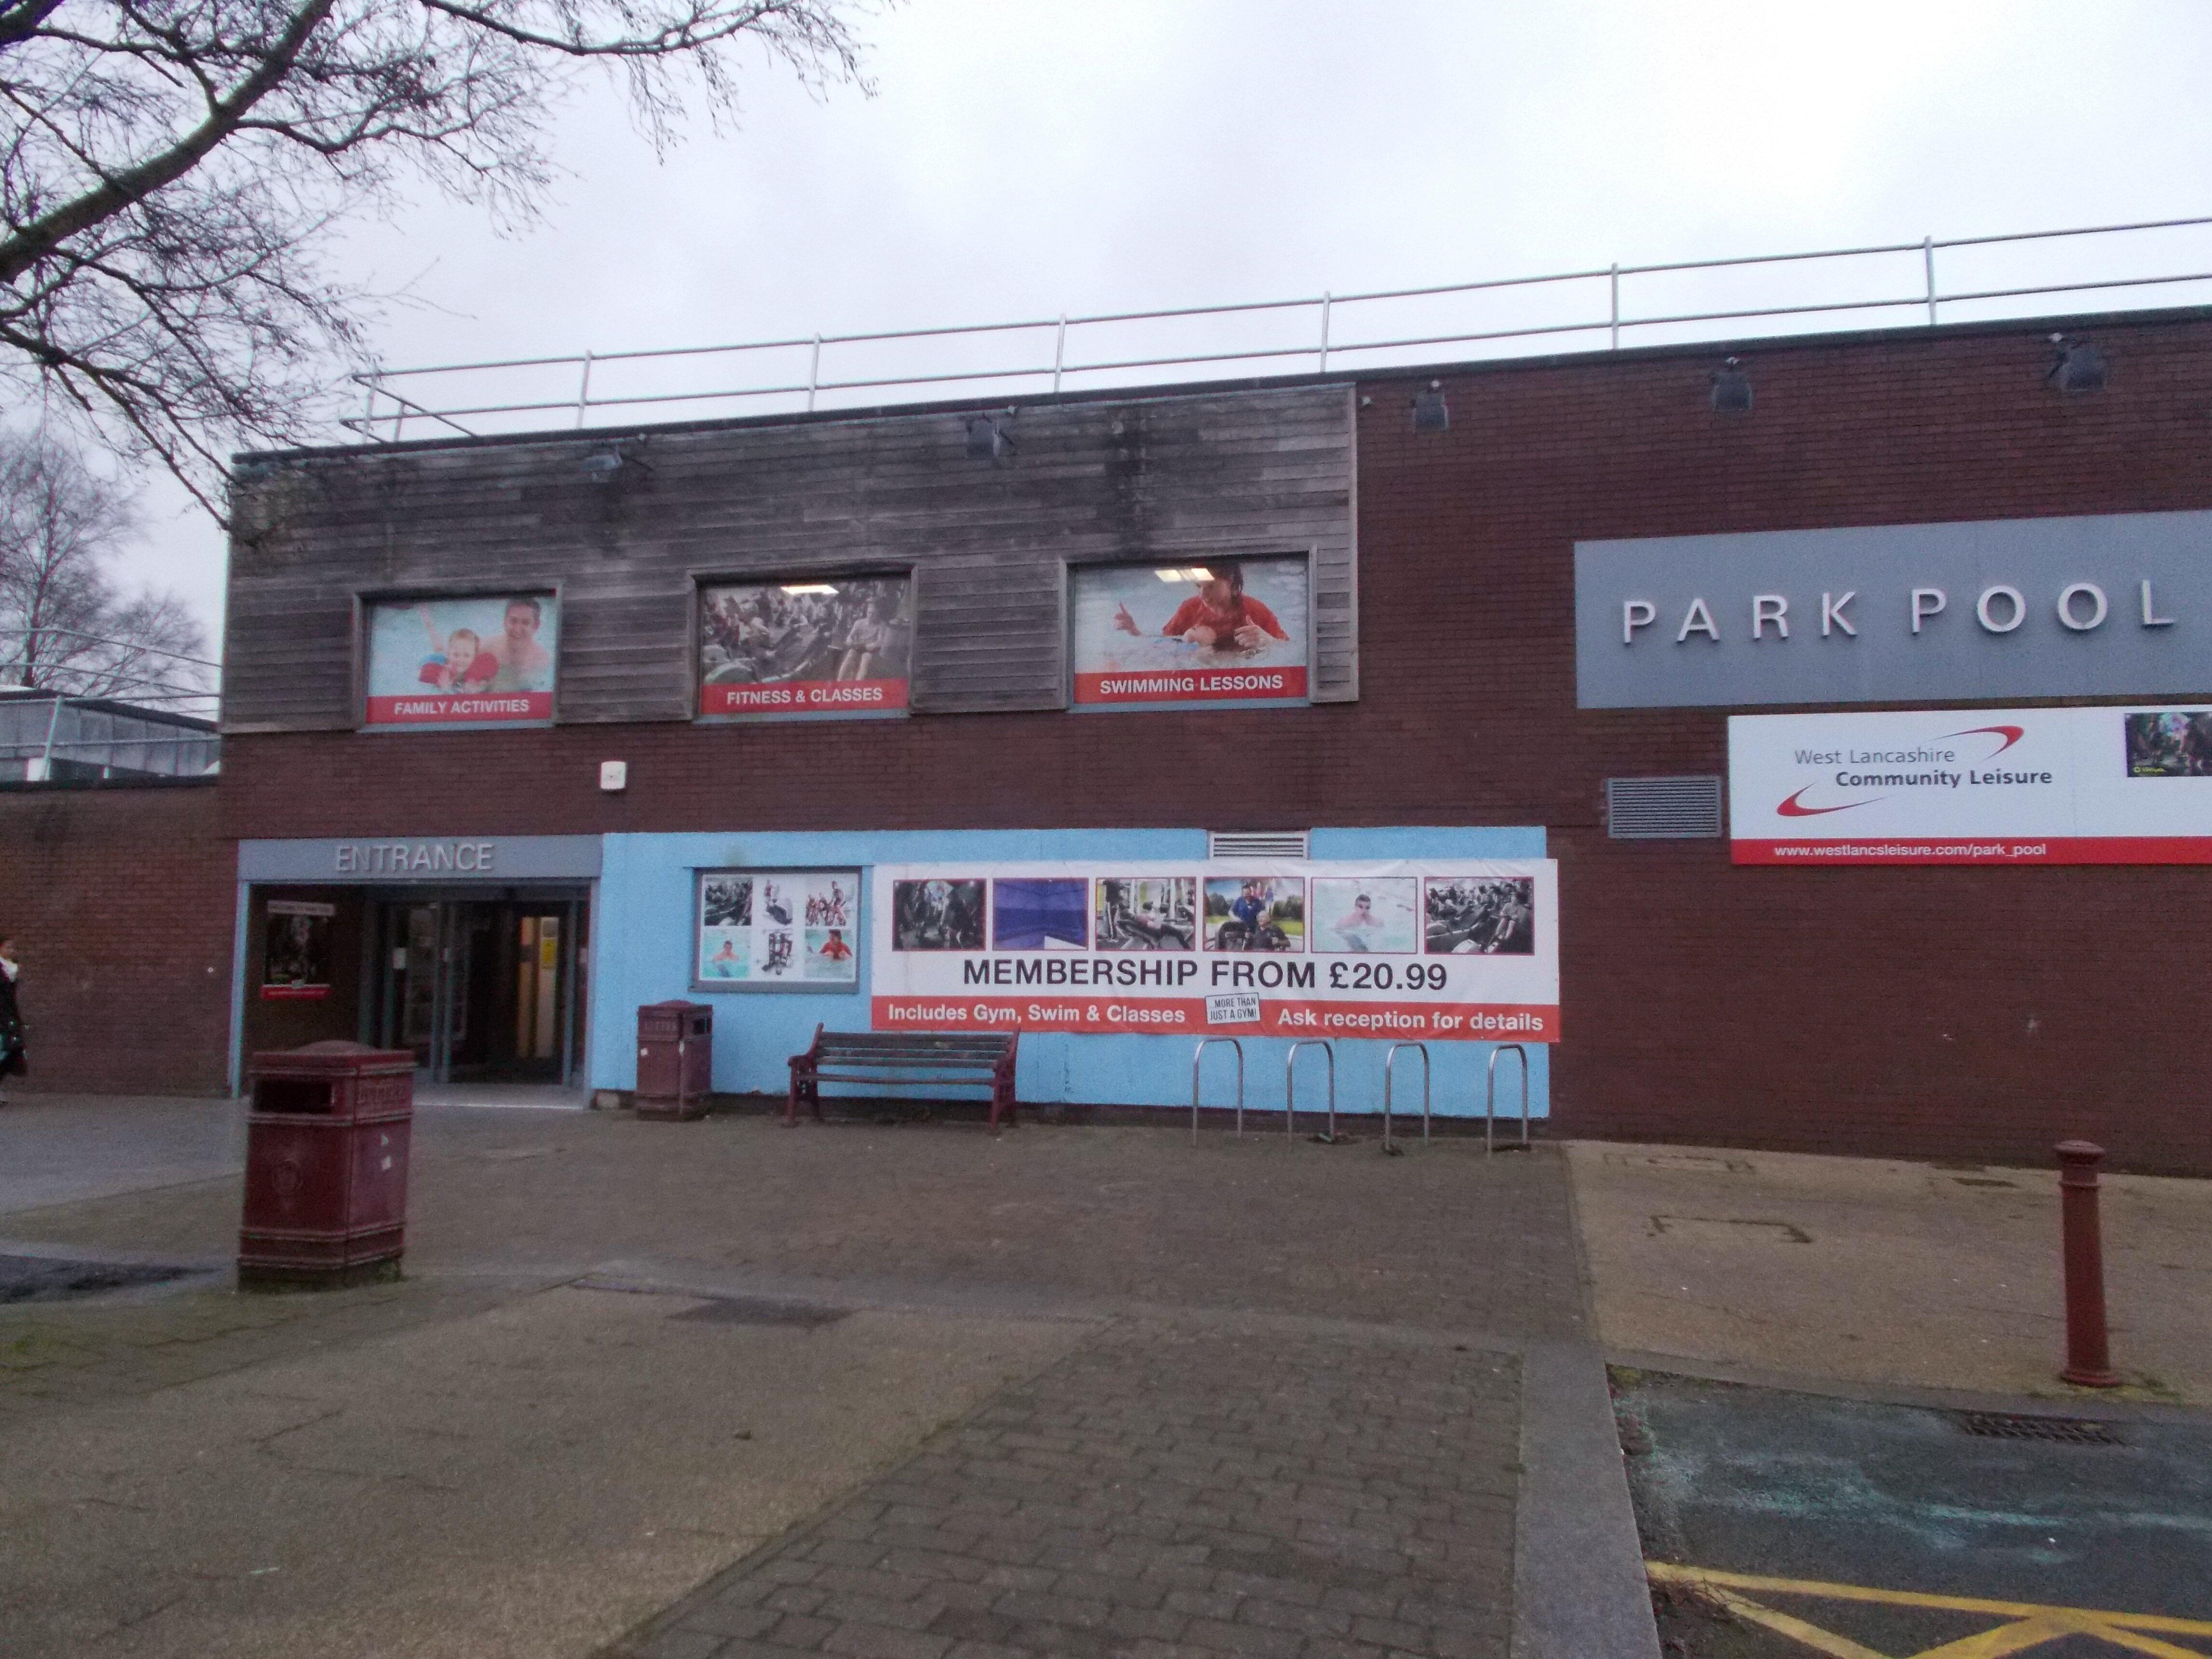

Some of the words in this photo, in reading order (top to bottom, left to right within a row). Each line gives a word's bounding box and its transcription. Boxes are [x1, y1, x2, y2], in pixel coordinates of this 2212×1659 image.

[1623, 591, 1857, 644] PARK
[1911, 579, 2176, 633] POOL
[1100, 677, 1194, 694] SWIMMING
[1201, 675, 1283, 691] LESSONS
[727, 690, 791, 705] FITNESS
[795, 691, 806, 703] &
[810, 687, 883, 702] CLASSES
[395, 701, 448, 715] FAMILY
[451, 699, 530, 713] ACTIVITIES
[1794, 748, 1842, 764] West
[1850, 747, 1955, 763] Lancashire
[1836, 769, 1962, 788] Community
[1970, 768, 2052, 785] Leisure
[336, 843, 494, 871] ENTRANCE
[1775, 843, 2047, 857] www.westlancsleisure.com/park_pool
[964, 959, 1198, 986] MEMBERSHIP
[1211, 960, 1315, 989] FROM
[1329, 962, 1447, 991] £20.99
[1215, 998, 1235, 1008] MORE
[1237, 997, 1256, 1006] THAN
[888, 1004, 967, 1020] Includes
[974, 1005, 1022, 1023] Gym,
[1028, 1005, 1079, 1021] Swim
[1086, 1006, 1100, 1021] &
[1106, 1005, 1185, 1023] Classes
[1210, 1009, 1227, 1020] JUST
[1230, 1009, 1235, 1019] A
[1237, 1008, 1257, 1019] GYM!
[1278, 1008, 1317, 1026] Ask
[1324, 1010, 1425, 1031] reception
[1433, 1011, 1463, 1029] for
[1470, 1012, 1543, 1031] details
